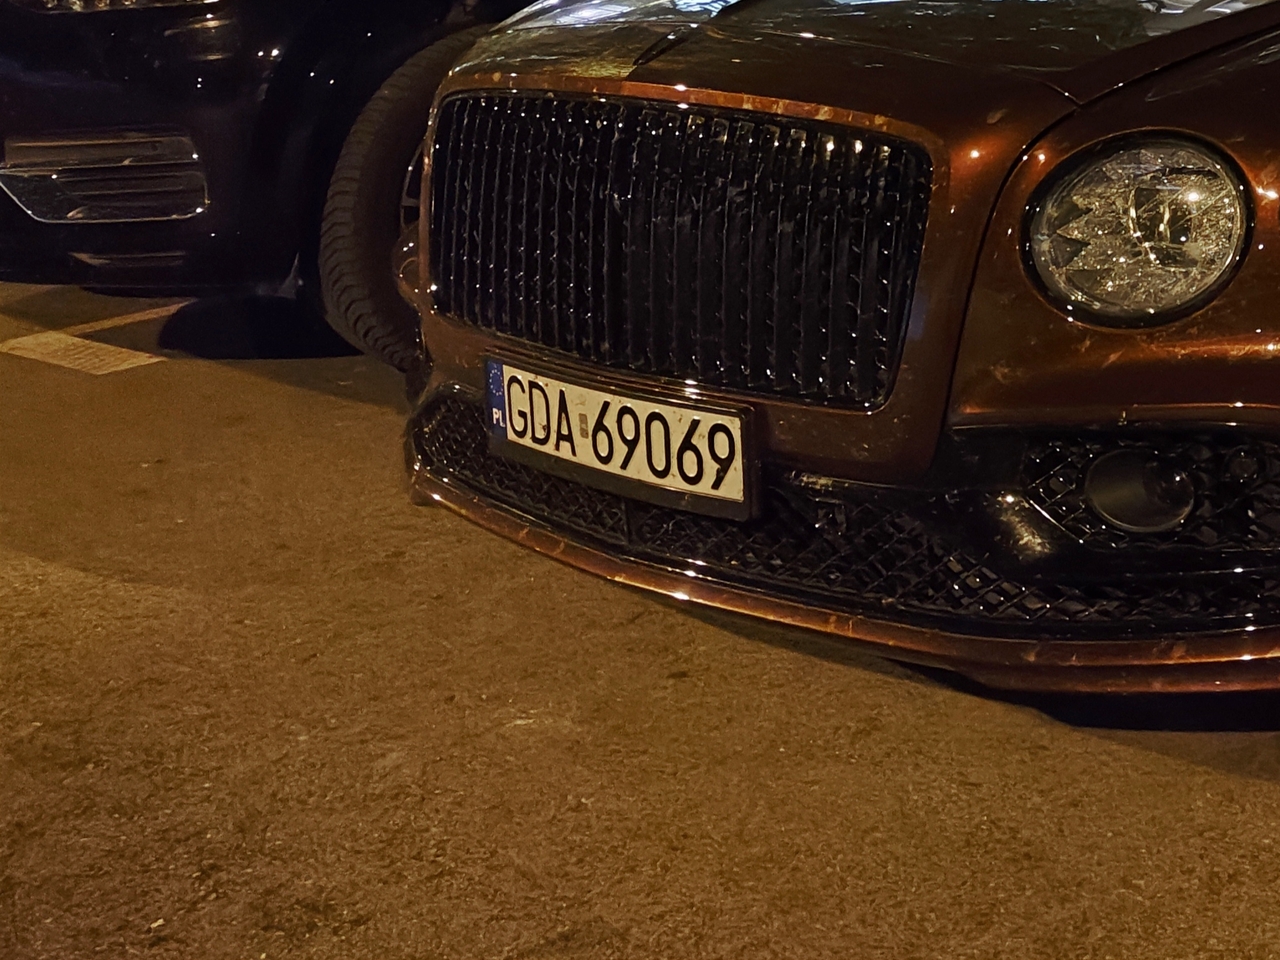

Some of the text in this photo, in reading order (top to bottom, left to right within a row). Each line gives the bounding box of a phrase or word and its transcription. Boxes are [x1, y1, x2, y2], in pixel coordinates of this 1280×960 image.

[492, 407, 505, 427] PL
[507, 375, 735, 490] GDA 69069
